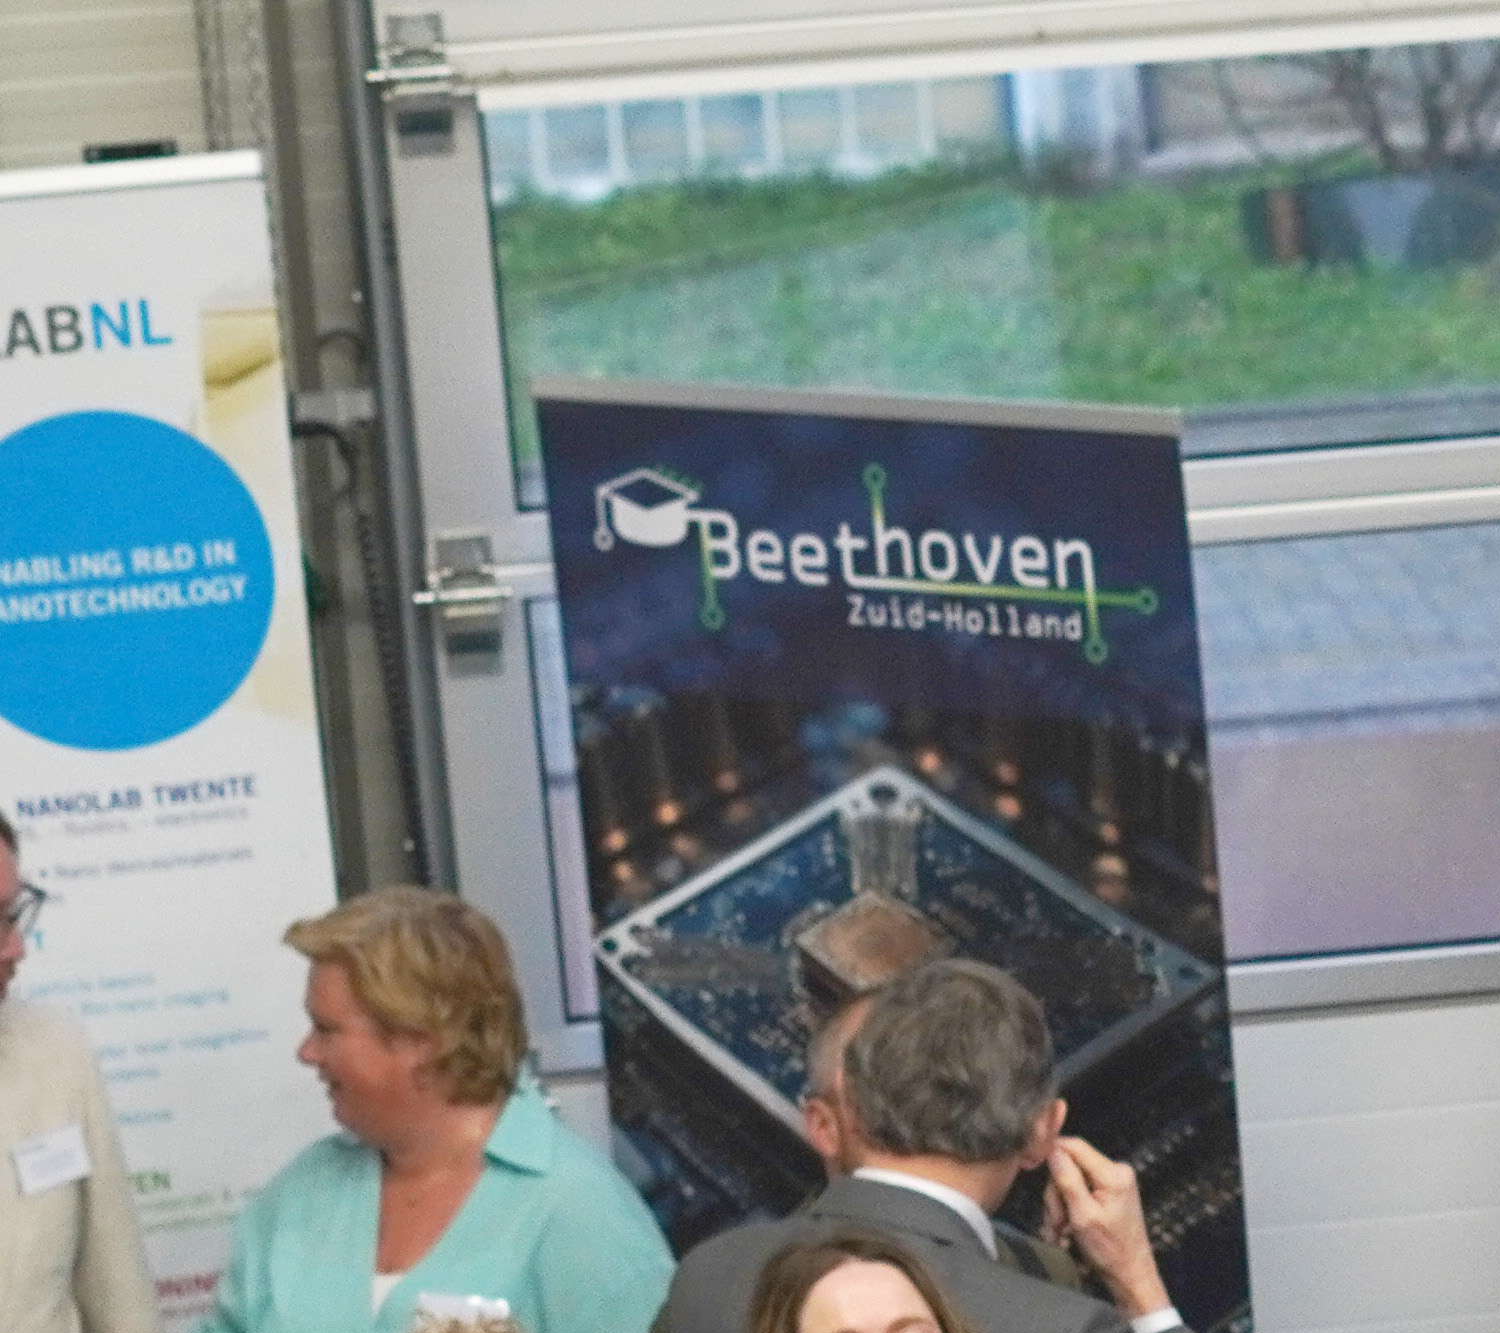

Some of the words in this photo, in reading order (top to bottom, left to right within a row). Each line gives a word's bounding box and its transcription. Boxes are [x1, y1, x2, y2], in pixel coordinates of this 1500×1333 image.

[0, 298, 173, 358] ABNL
[131, 543, 196, 575] R&D
[202, 539, 237, 569] IN
[700, 508, 1097, 592] Beethoven
[846, 594, 1084, 642] Zuid-Holland
[16, 786, 143, 818] NANOLAB
[152, 773, 256, 805] TWENTE
